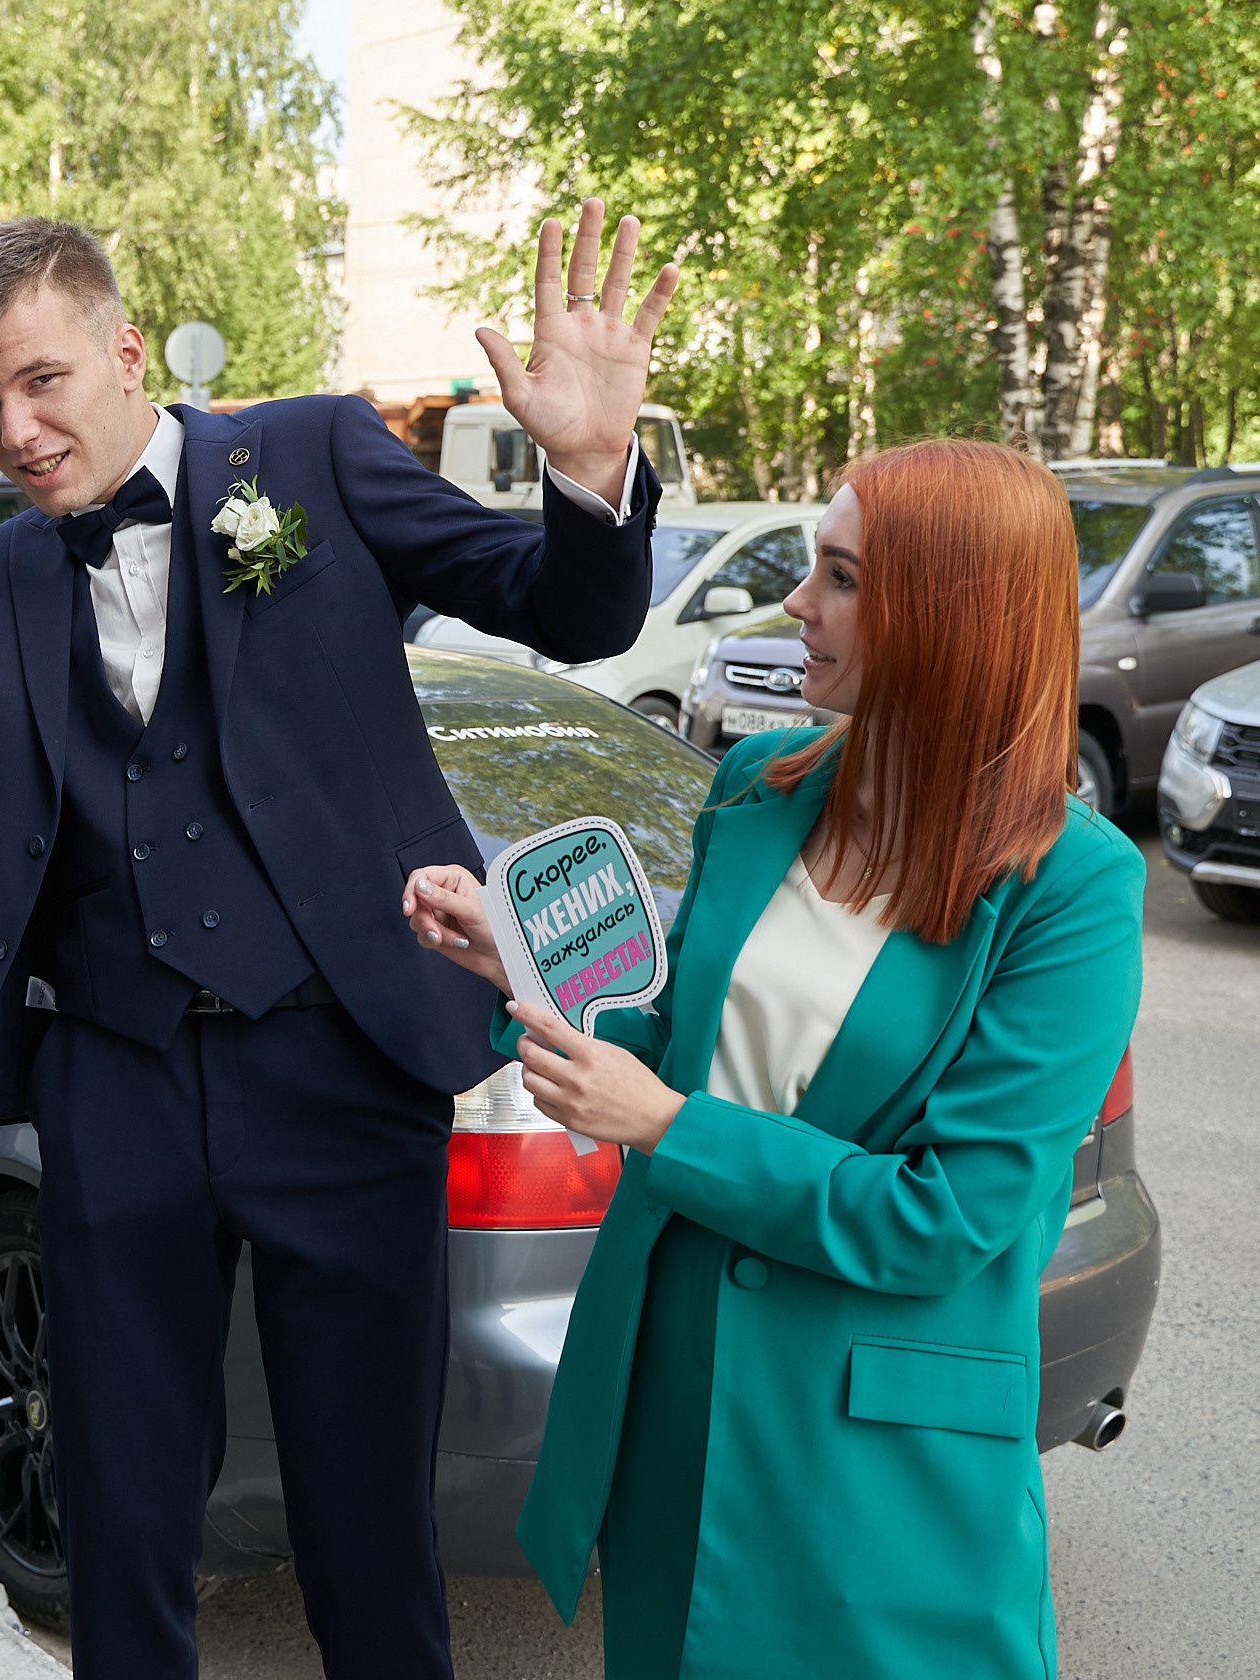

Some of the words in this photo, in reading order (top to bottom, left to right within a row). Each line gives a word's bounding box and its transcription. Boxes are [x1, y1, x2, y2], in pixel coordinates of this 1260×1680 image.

[426, 721, 600, 742] Ситимобил
[515, 835, 607, 903] Скорее,
[523, 862, 635, 954] ЖЕНИХ,
[540, 902, 636, 973] заждалась
[554, 930, 653, 1013] НЕВЕСТА!
